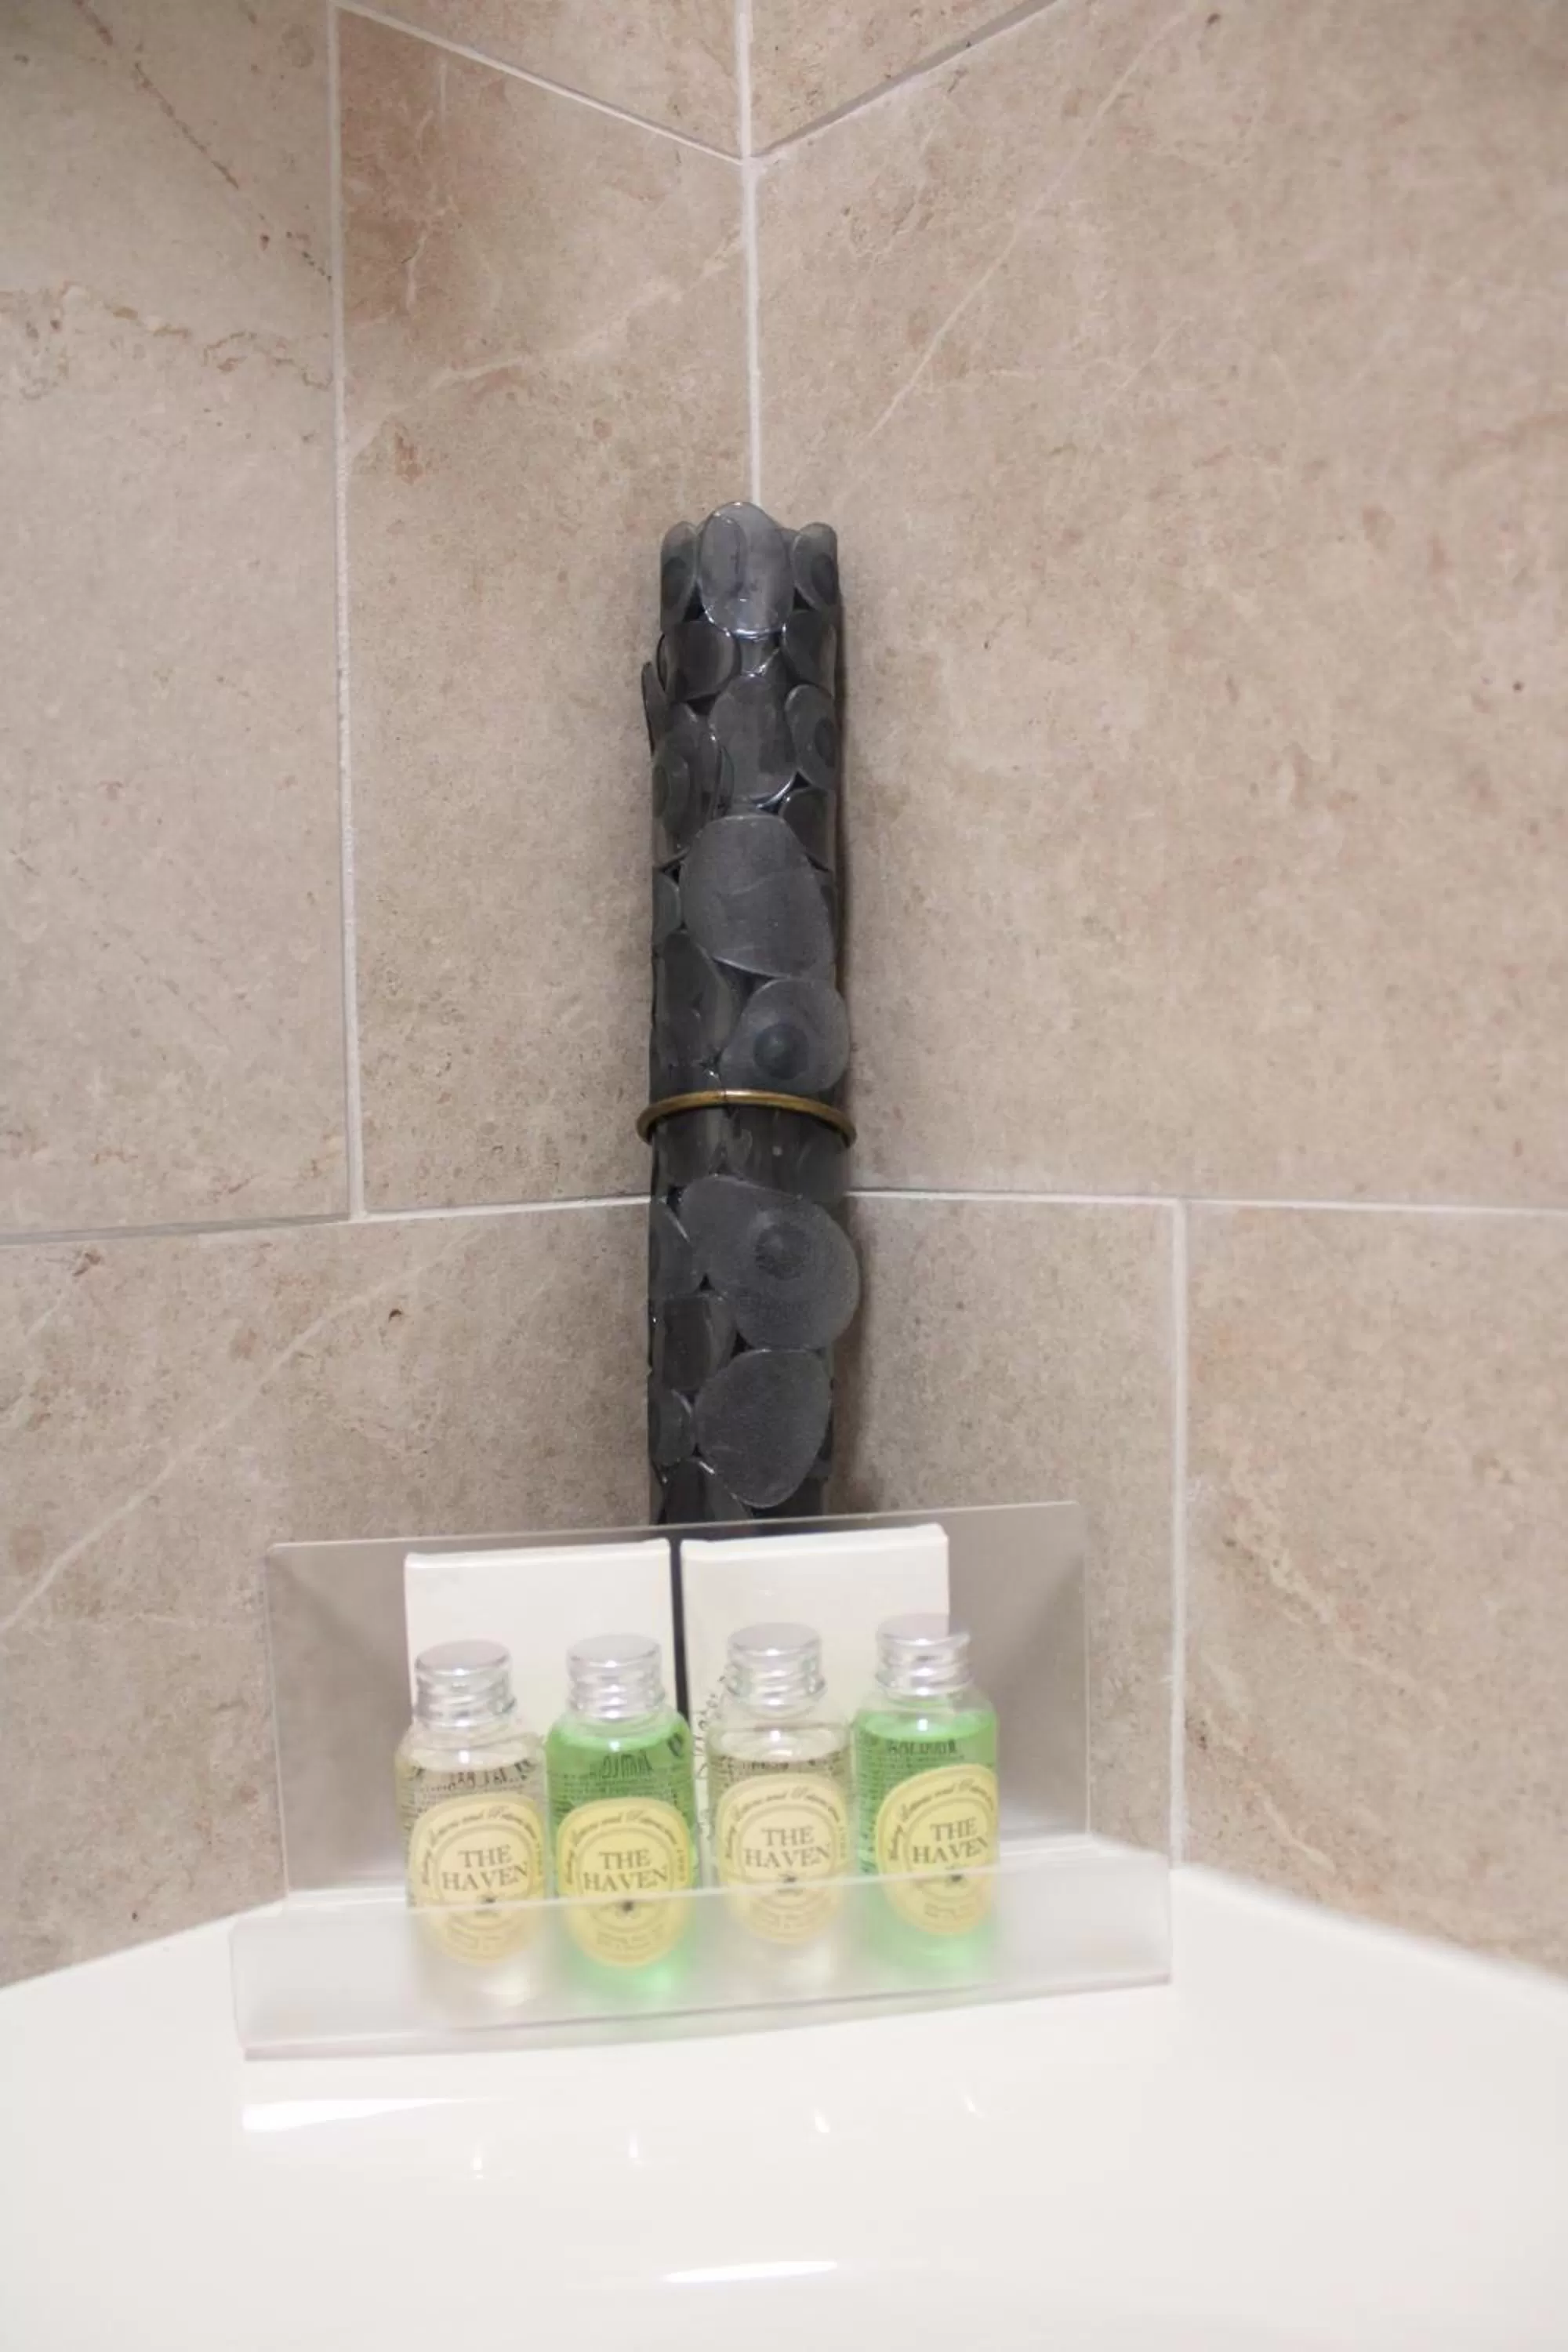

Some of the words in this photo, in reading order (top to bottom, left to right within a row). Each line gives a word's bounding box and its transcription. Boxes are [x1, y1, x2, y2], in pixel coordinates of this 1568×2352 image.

[761, 1825, 815, 1846] THE
[930, 1817, 978, 1841] THE
[458, 1844, 514, 1867] THE
[598, 1849, 652, 1870] THE
[745, 1842, 831, 1867] HAVEN
[913, 1835, 989, 1864] HAVEN
[442, 1861, 527, 1891] HAVEN
[583, 1864, 669, 1891] HAVEN
